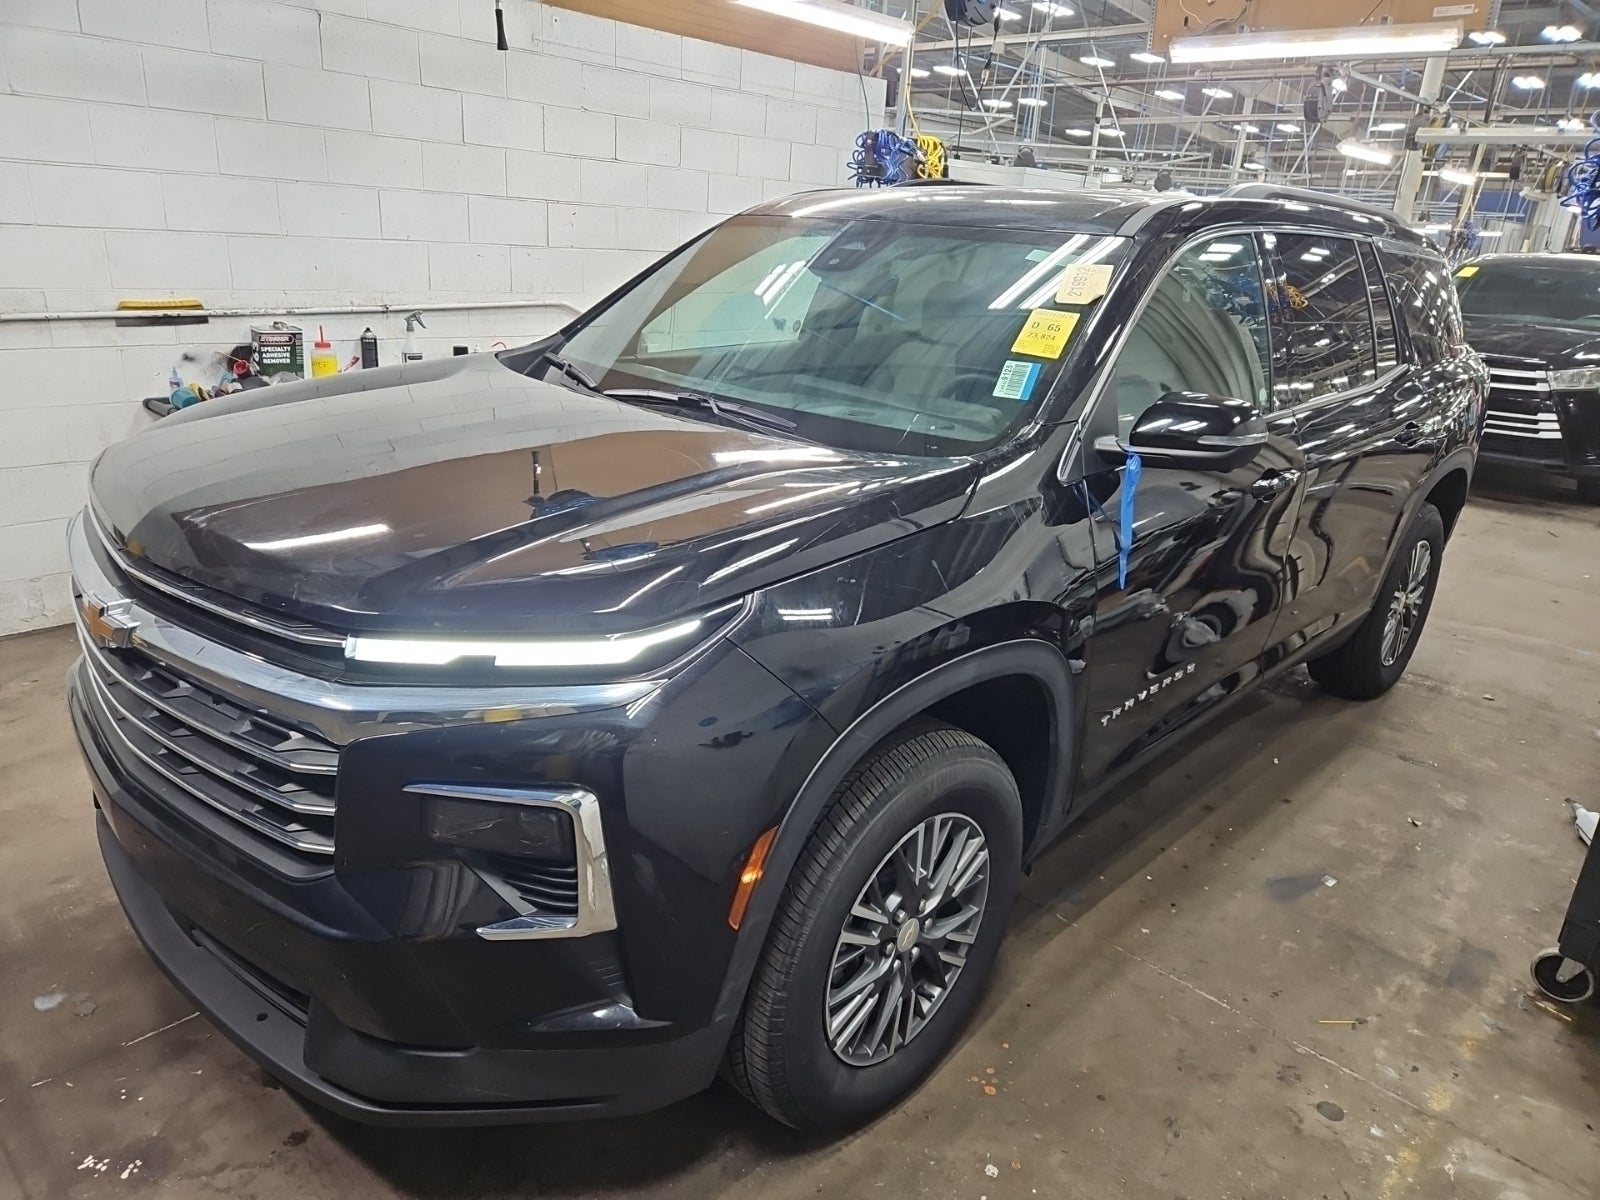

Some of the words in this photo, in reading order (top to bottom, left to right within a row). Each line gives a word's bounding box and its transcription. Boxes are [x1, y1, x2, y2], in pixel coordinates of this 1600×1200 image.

[1067, 266, 1091, 297] 219912
[1047, 323, 1061, 332] 65
[1100, 663, 1196, 727] TRAVERSE
